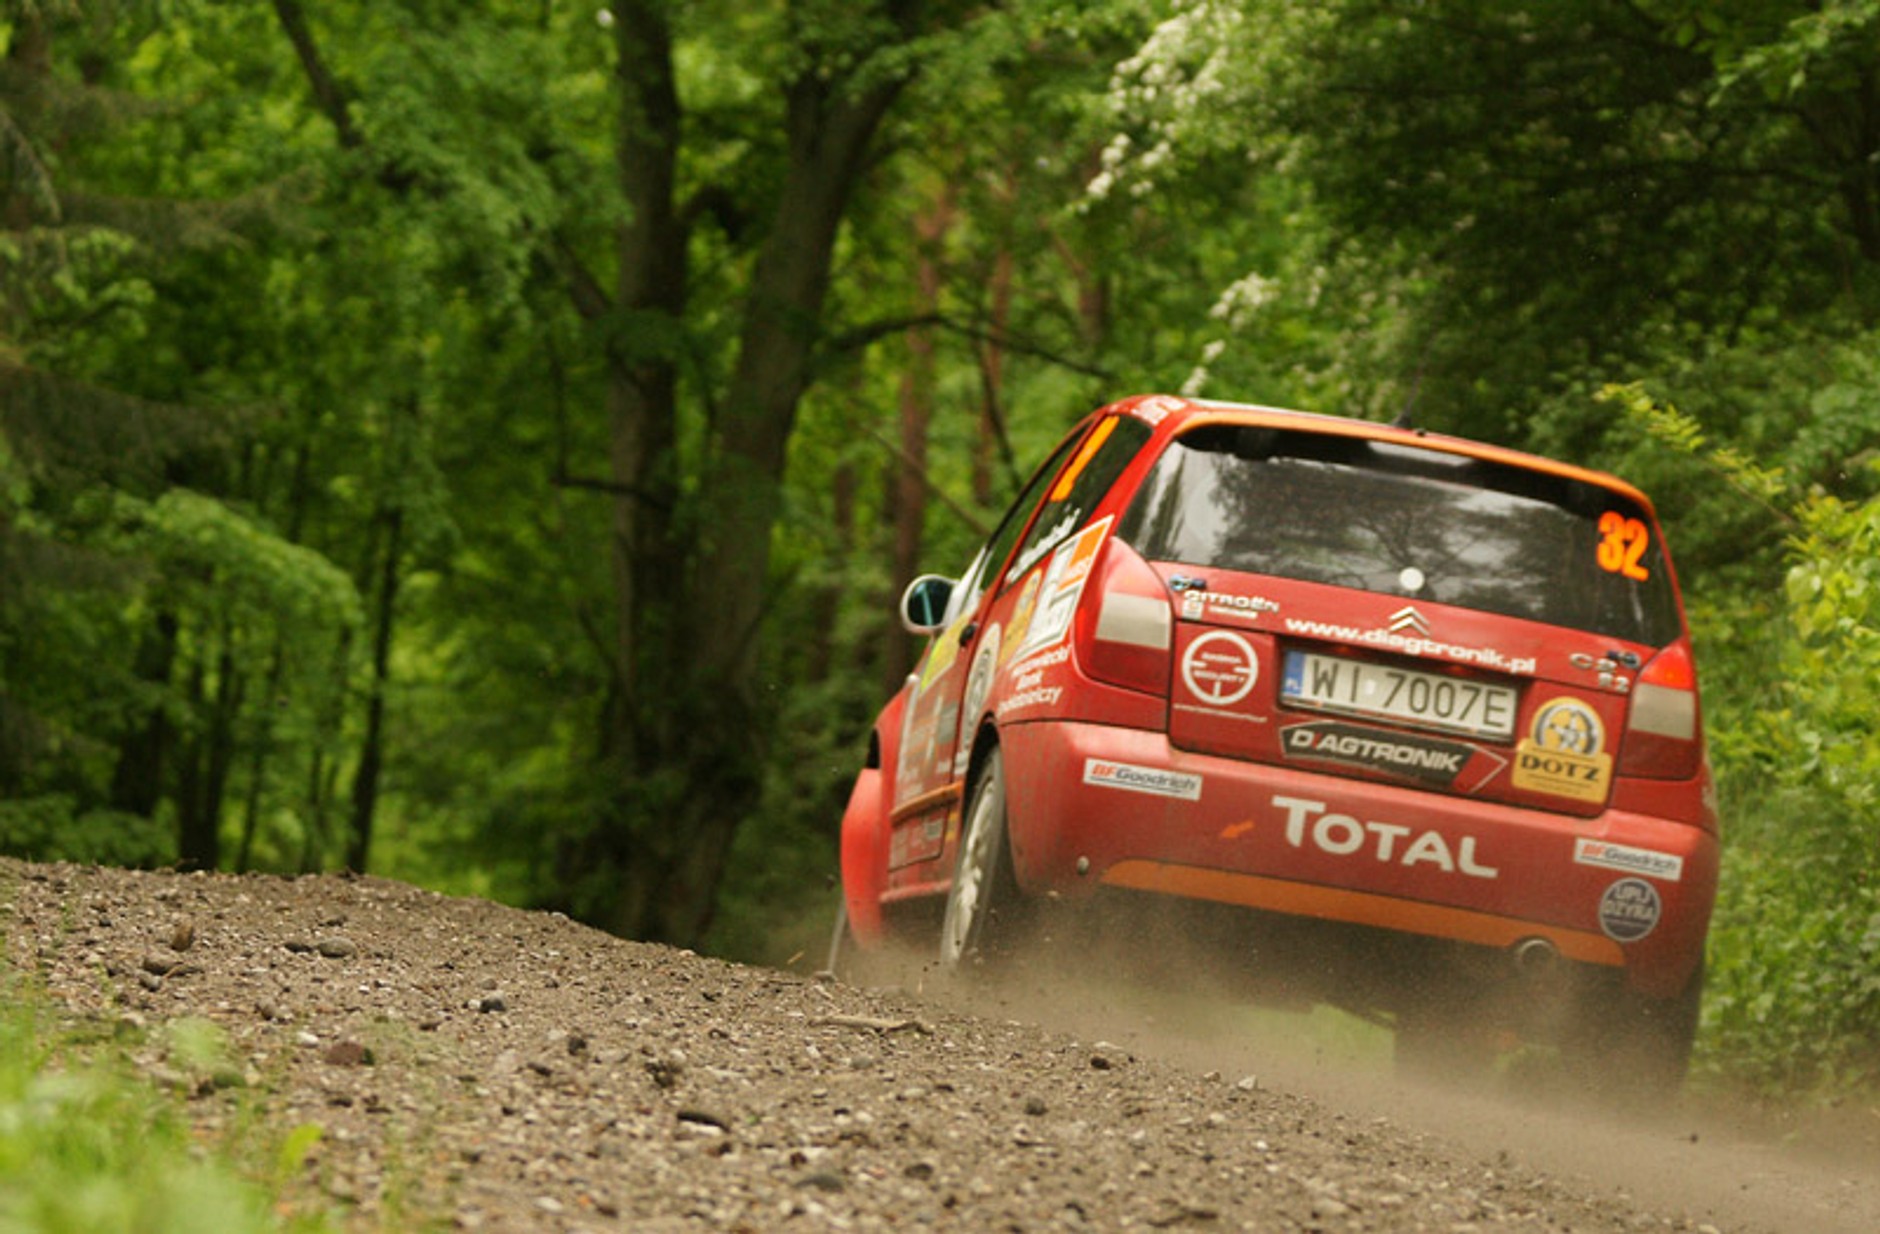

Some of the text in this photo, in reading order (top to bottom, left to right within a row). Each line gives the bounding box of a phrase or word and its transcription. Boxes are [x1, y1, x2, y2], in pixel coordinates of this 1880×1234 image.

[1596, 510, 1649, 581] 32
[1285, 617, 1536, 674] www.diagtronik.pl
[1382, 672, 1508, 728] 7007E
[1290, 729, 1464, 772] DIAGTRONIK
[1521, 753, 1600, 782] DOTZ
[1092, 764, 1196, 790] BFGoodrich
[1582, 844, 1677, 871] BFGoodrich
